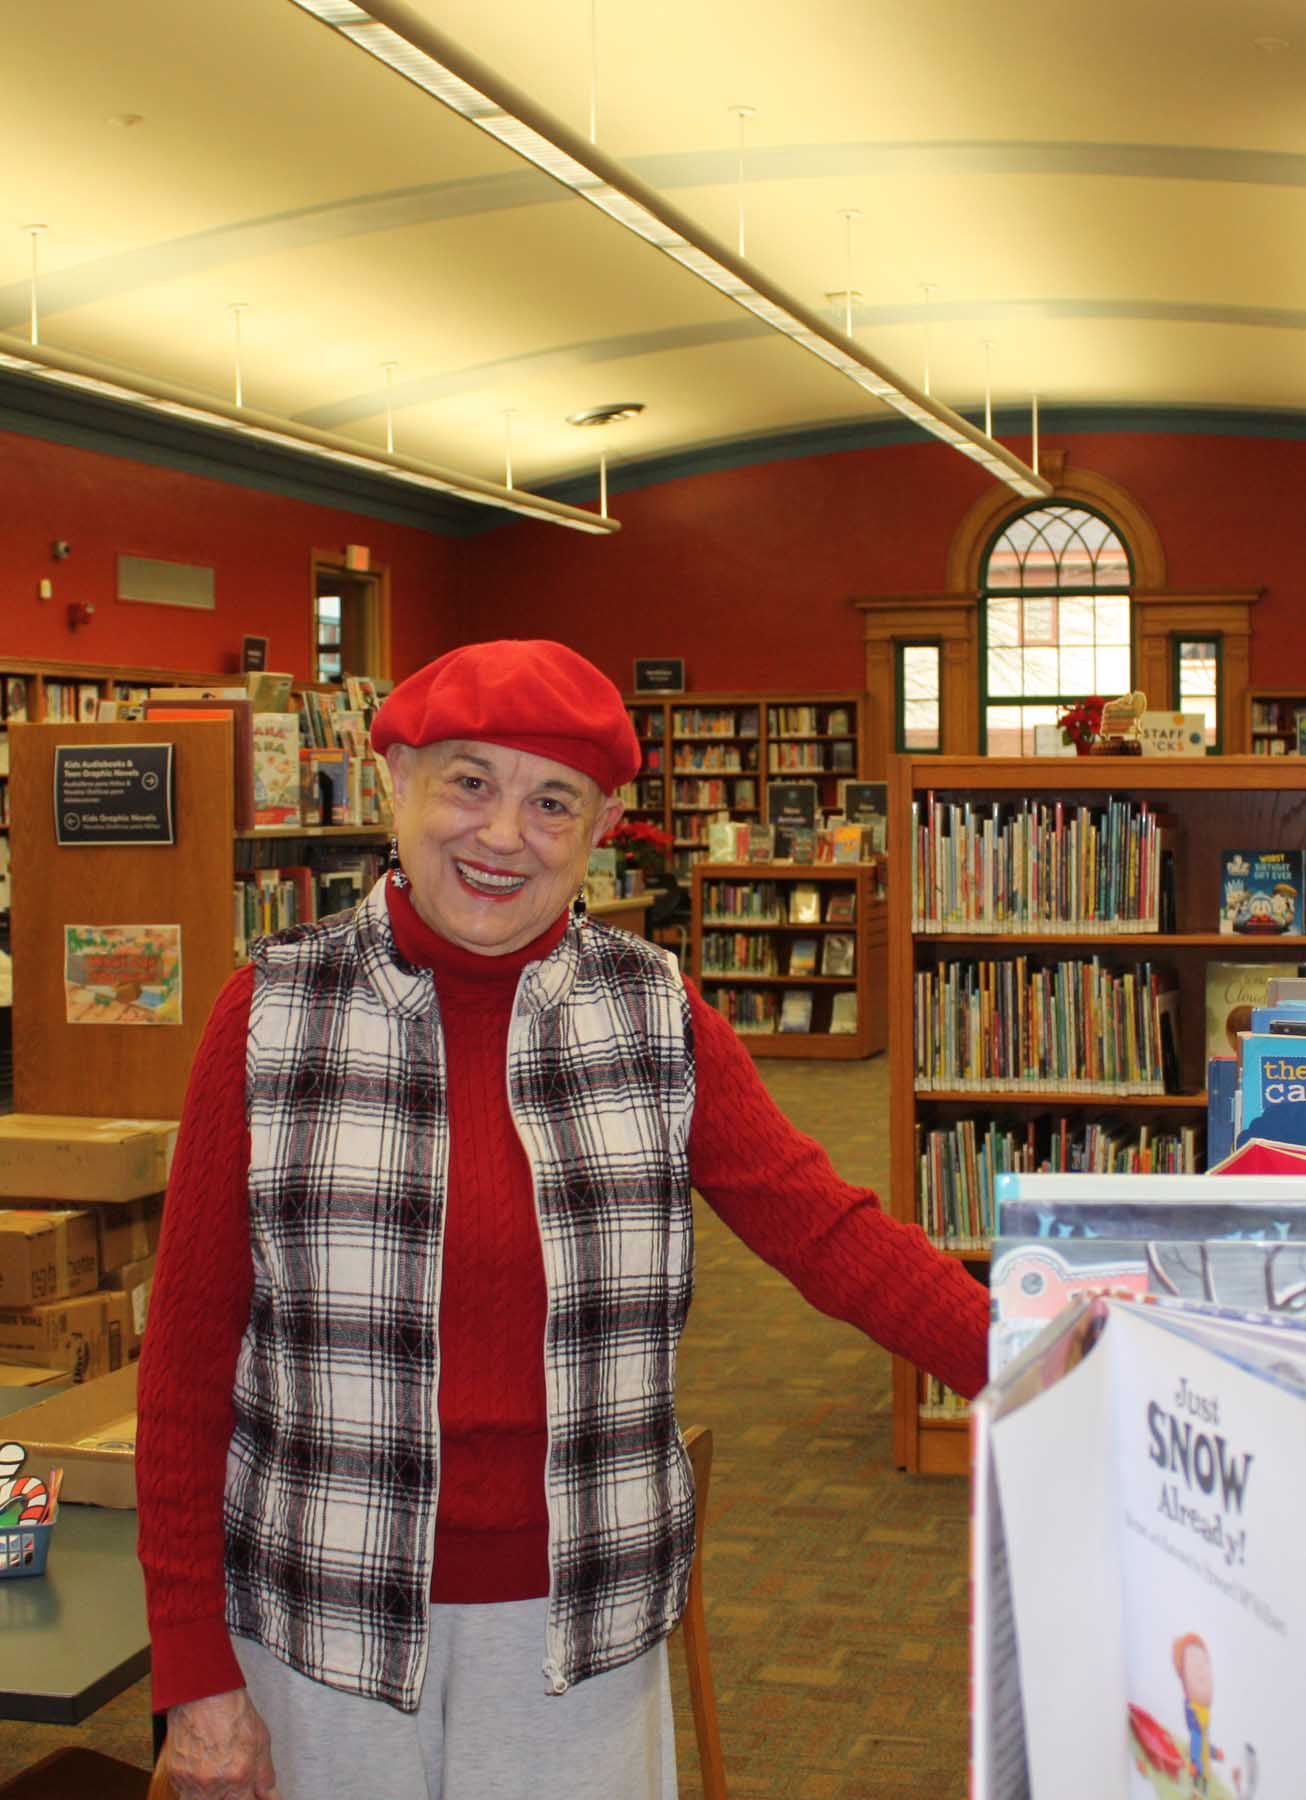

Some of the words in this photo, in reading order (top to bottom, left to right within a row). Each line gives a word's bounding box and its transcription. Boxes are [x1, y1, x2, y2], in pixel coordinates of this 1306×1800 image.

[1143, 728, 1184, 739] STAFF
[64, 760, 81, 768] Kids
[82, 769, 113, 779] Graphic
[113, 769, 140, 777] Novels
[82, 814, 98, 822] Kids
[99, 814, 129, 824] Graphic
[131, 814, 157, 822] Novels
[1175, 1377, 1220, 1426] Just
[1148, 1399, 1255, 1515] SNOW
[1157, 1481, 1247, 1567] Already!
